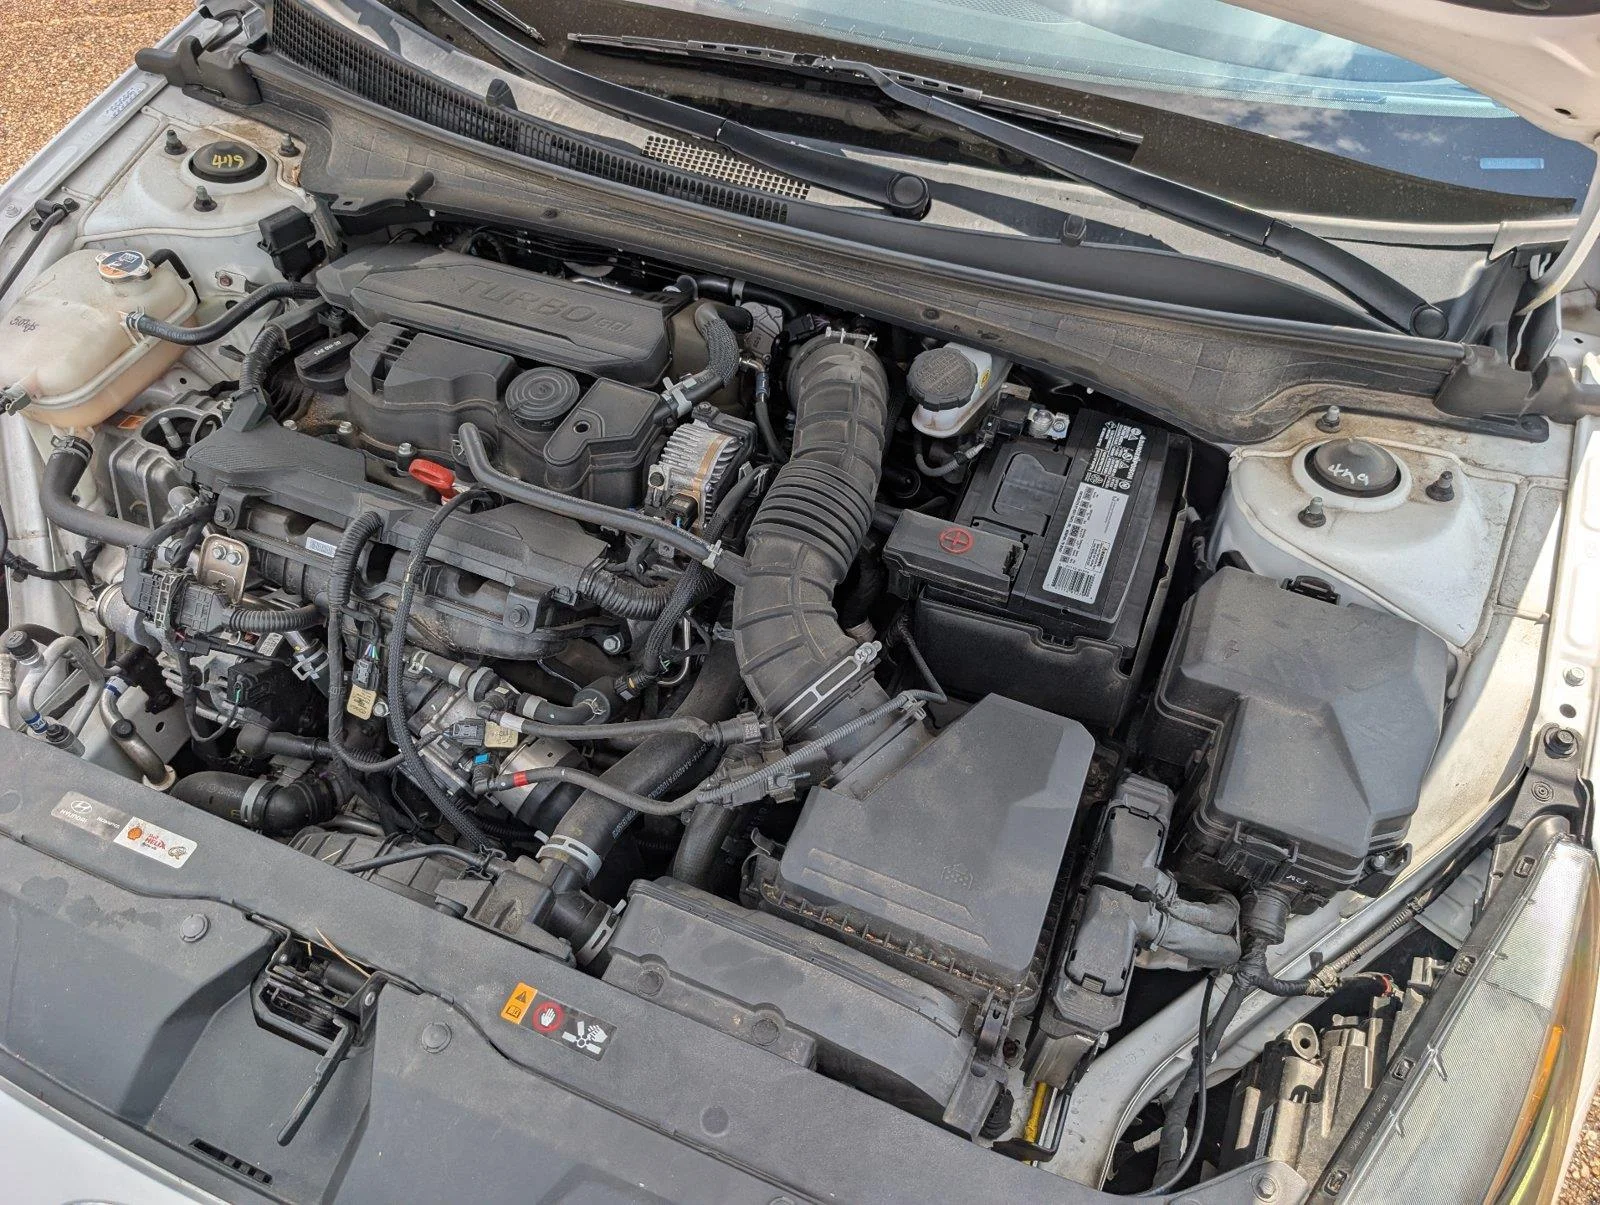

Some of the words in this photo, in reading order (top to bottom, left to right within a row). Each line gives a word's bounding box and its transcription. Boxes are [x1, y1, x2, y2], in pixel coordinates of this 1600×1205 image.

[212, 154, 245, 169] 419
[458, 277, 597, 322] TURBO
[60, 808, 88, 824] HYUNDAI
[144, 836, 166, 850] HELIX
